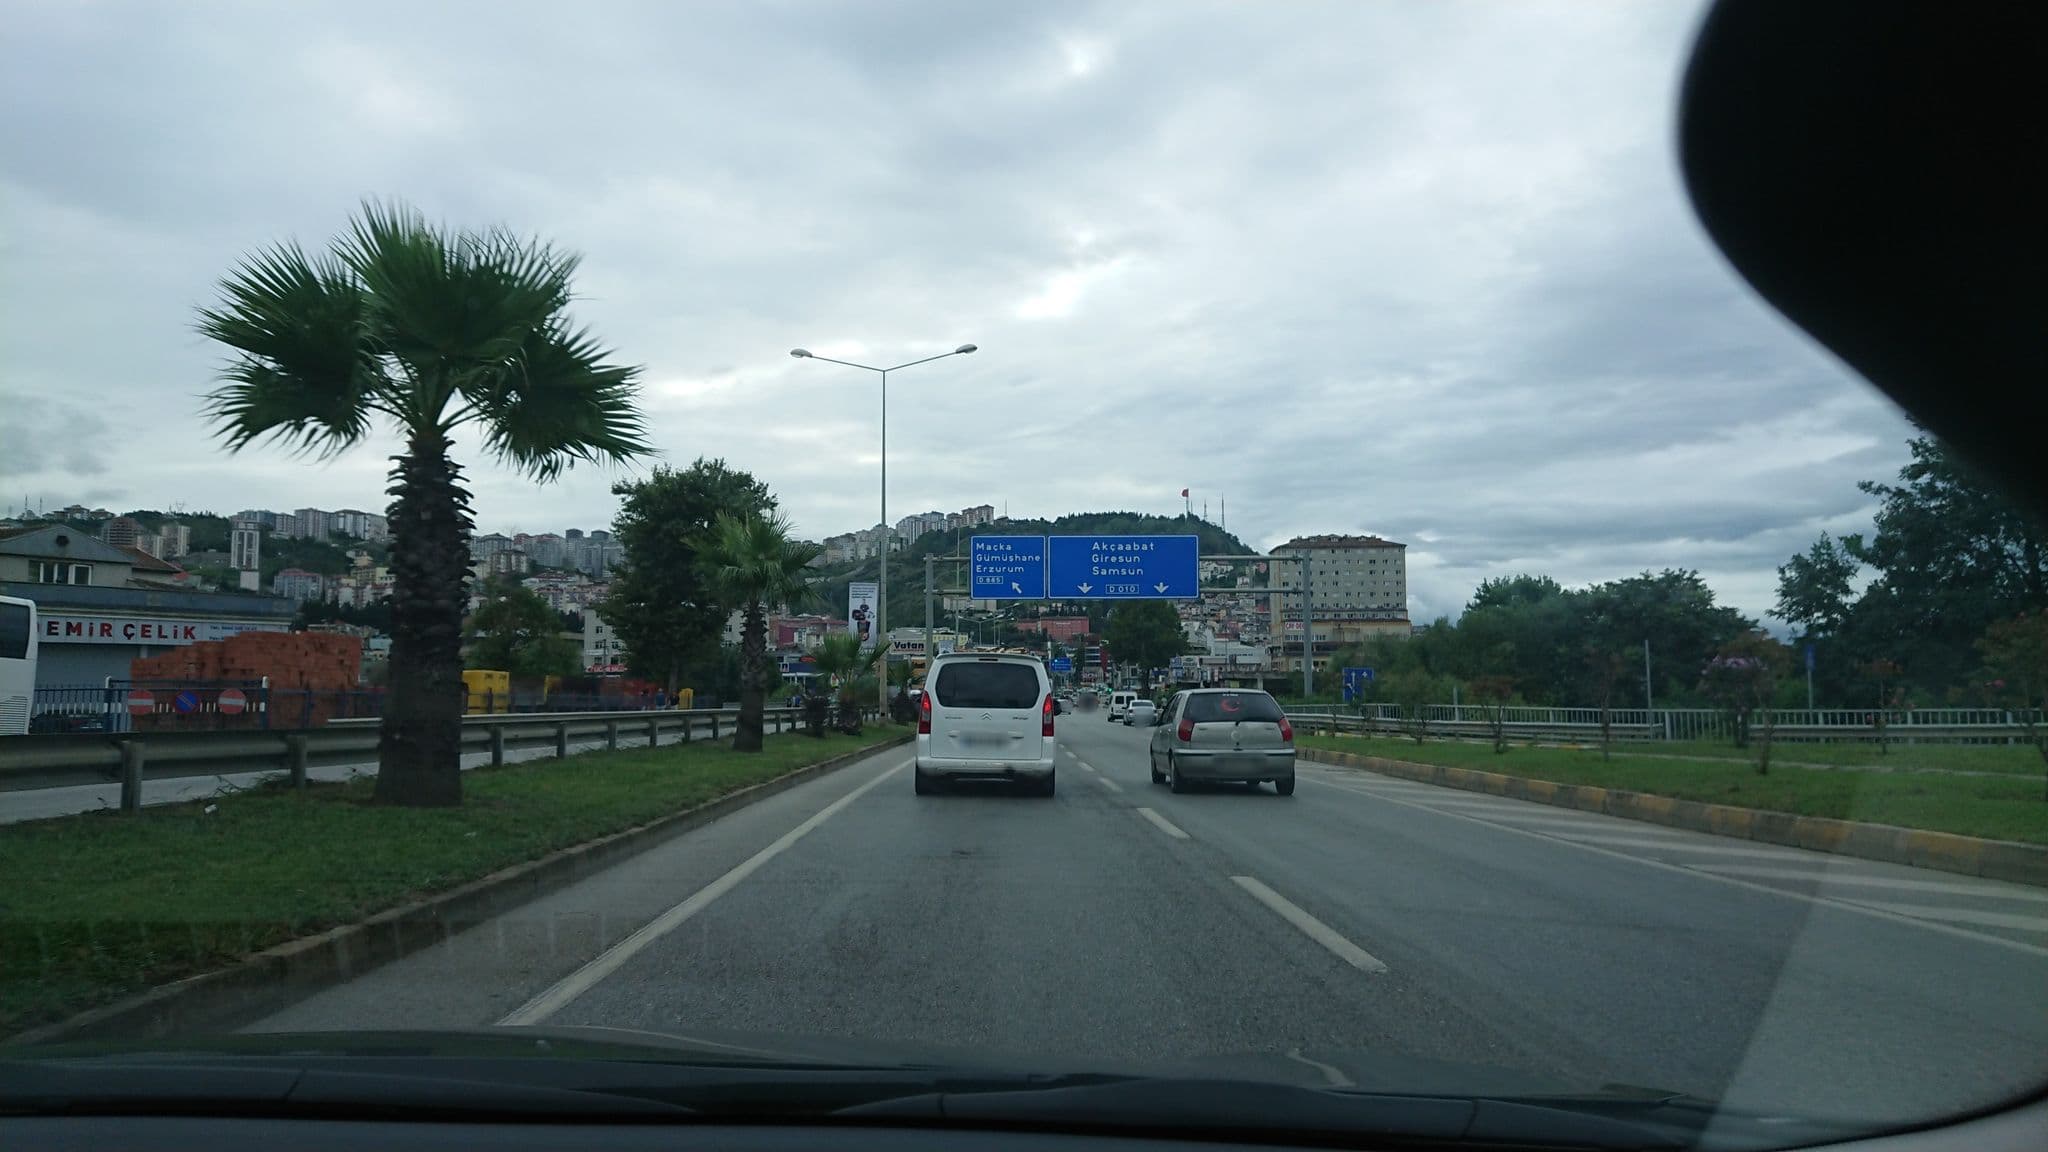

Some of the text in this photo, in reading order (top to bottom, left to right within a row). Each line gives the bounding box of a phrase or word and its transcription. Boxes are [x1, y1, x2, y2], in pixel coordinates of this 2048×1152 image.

[976, 542, 1012, 551] Maçka
[1092, 541, 1154, 552] Akçaabat
[1092, 554, 1141, 563] Giresun
[976, 564, 1025, 573] Erzurum
[1092, 566, 1144, 575] Samsun
[37, 621, 113, 638] EMİR
[894, 641, 924, 649] Vatan
